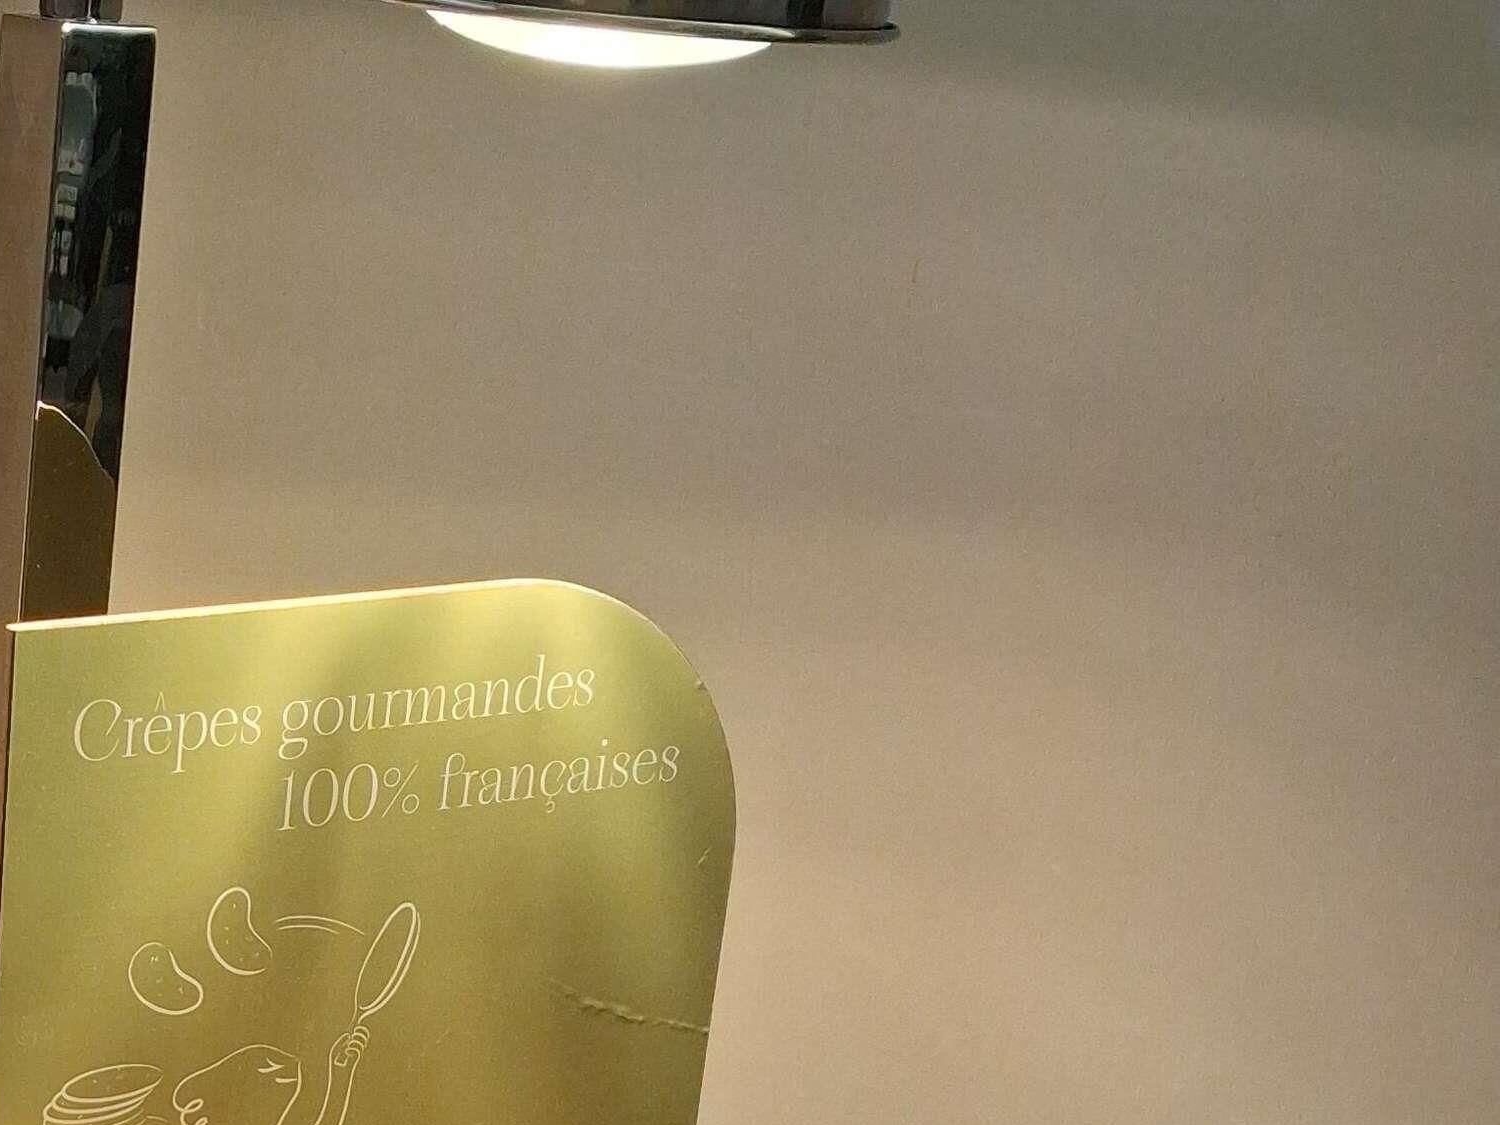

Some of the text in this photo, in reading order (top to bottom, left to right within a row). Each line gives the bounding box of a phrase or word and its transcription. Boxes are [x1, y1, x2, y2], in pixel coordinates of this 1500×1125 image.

[73, 654, 598, 775] Crêpes gourmandes
[275, 738, 682, 832] 100% françaises
